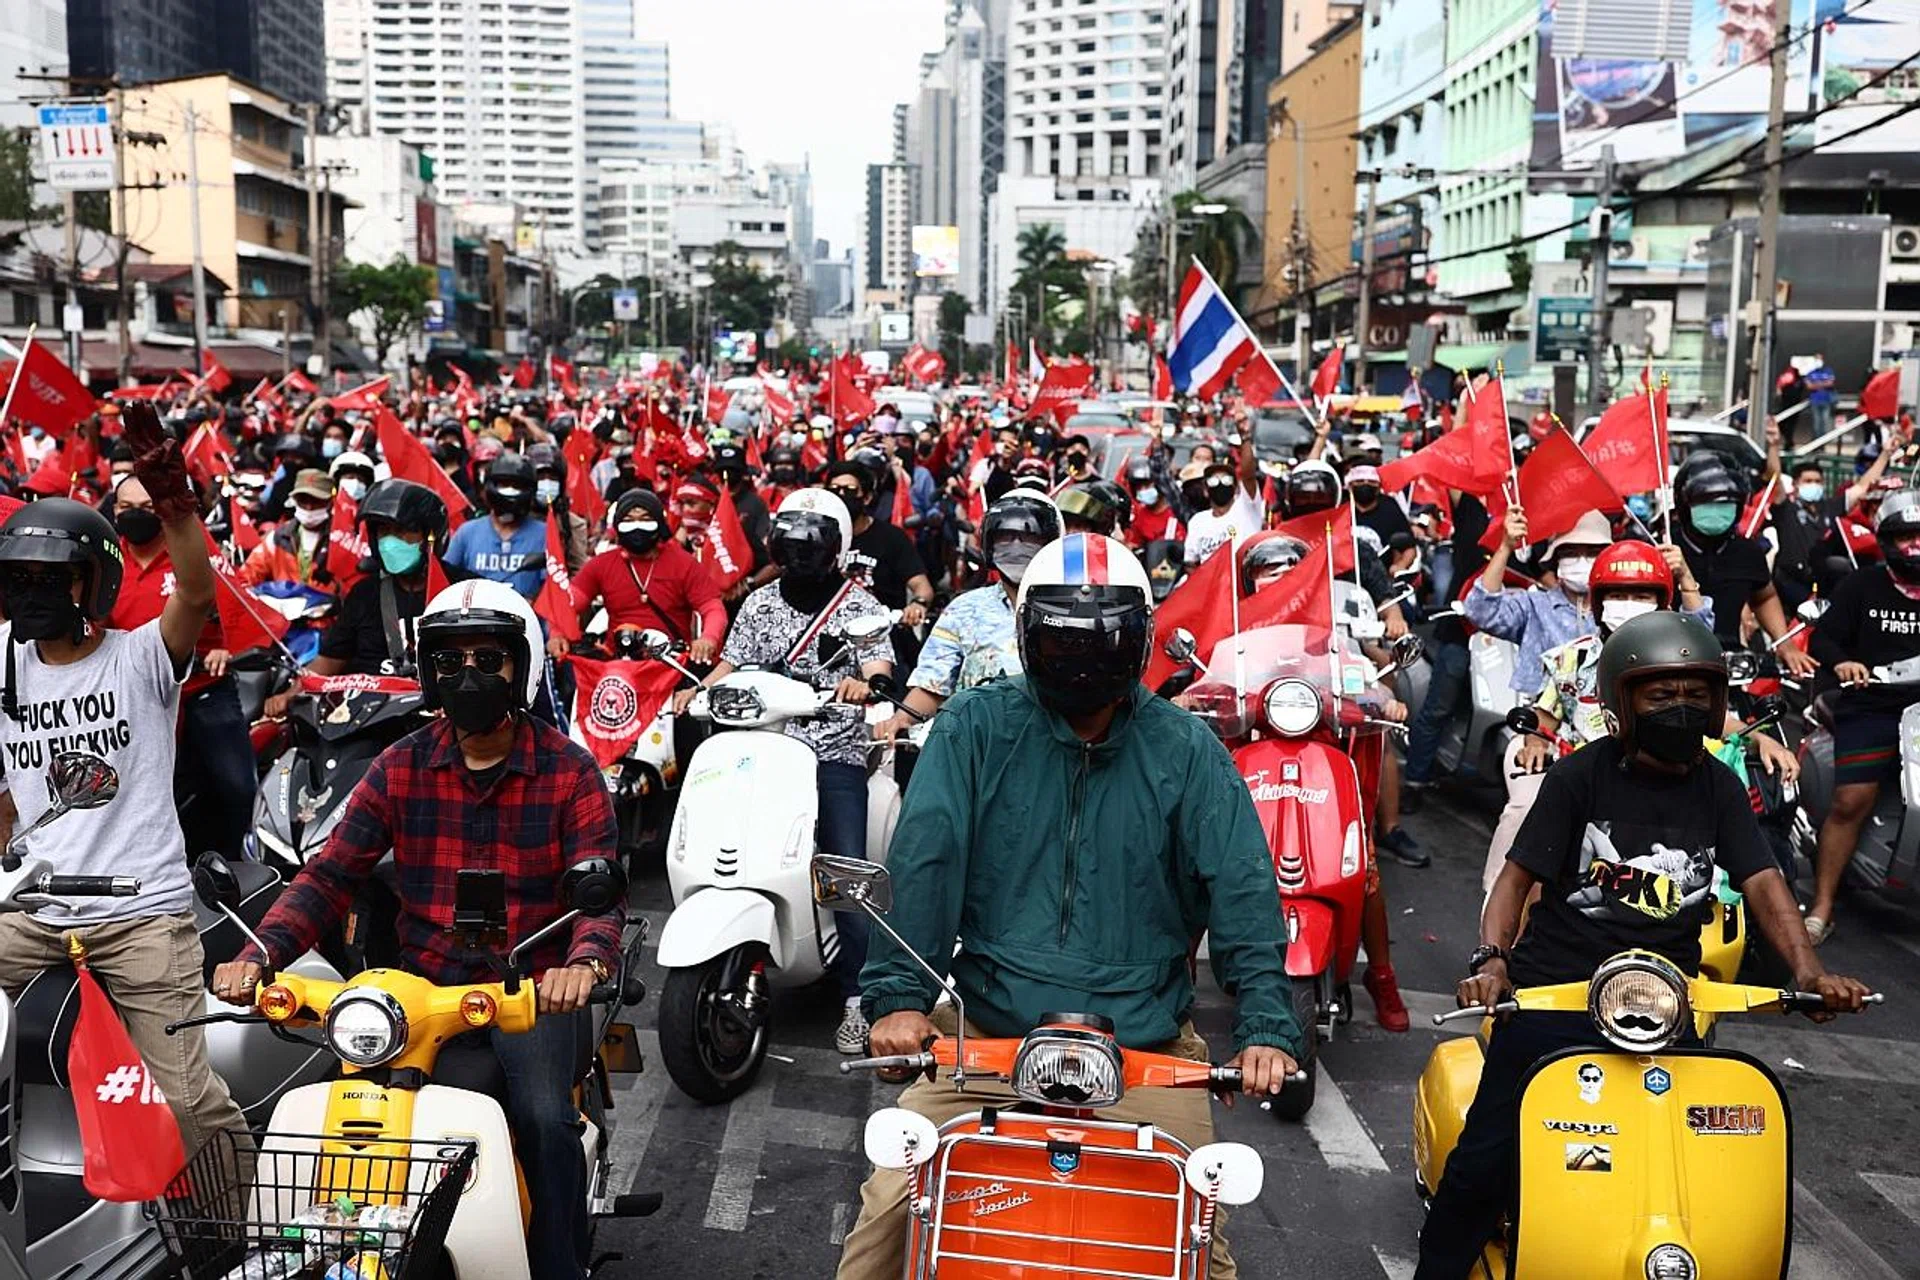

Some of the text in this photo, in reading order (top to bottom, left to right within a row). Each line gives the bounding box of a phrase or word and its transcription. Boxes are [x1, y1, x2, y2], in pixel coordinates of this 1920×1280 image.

[18, 691, 115, 733] FUCK YOU
[6, 739, 43, 770] YOU
[342, 1091, 389, 1102] HONDA
